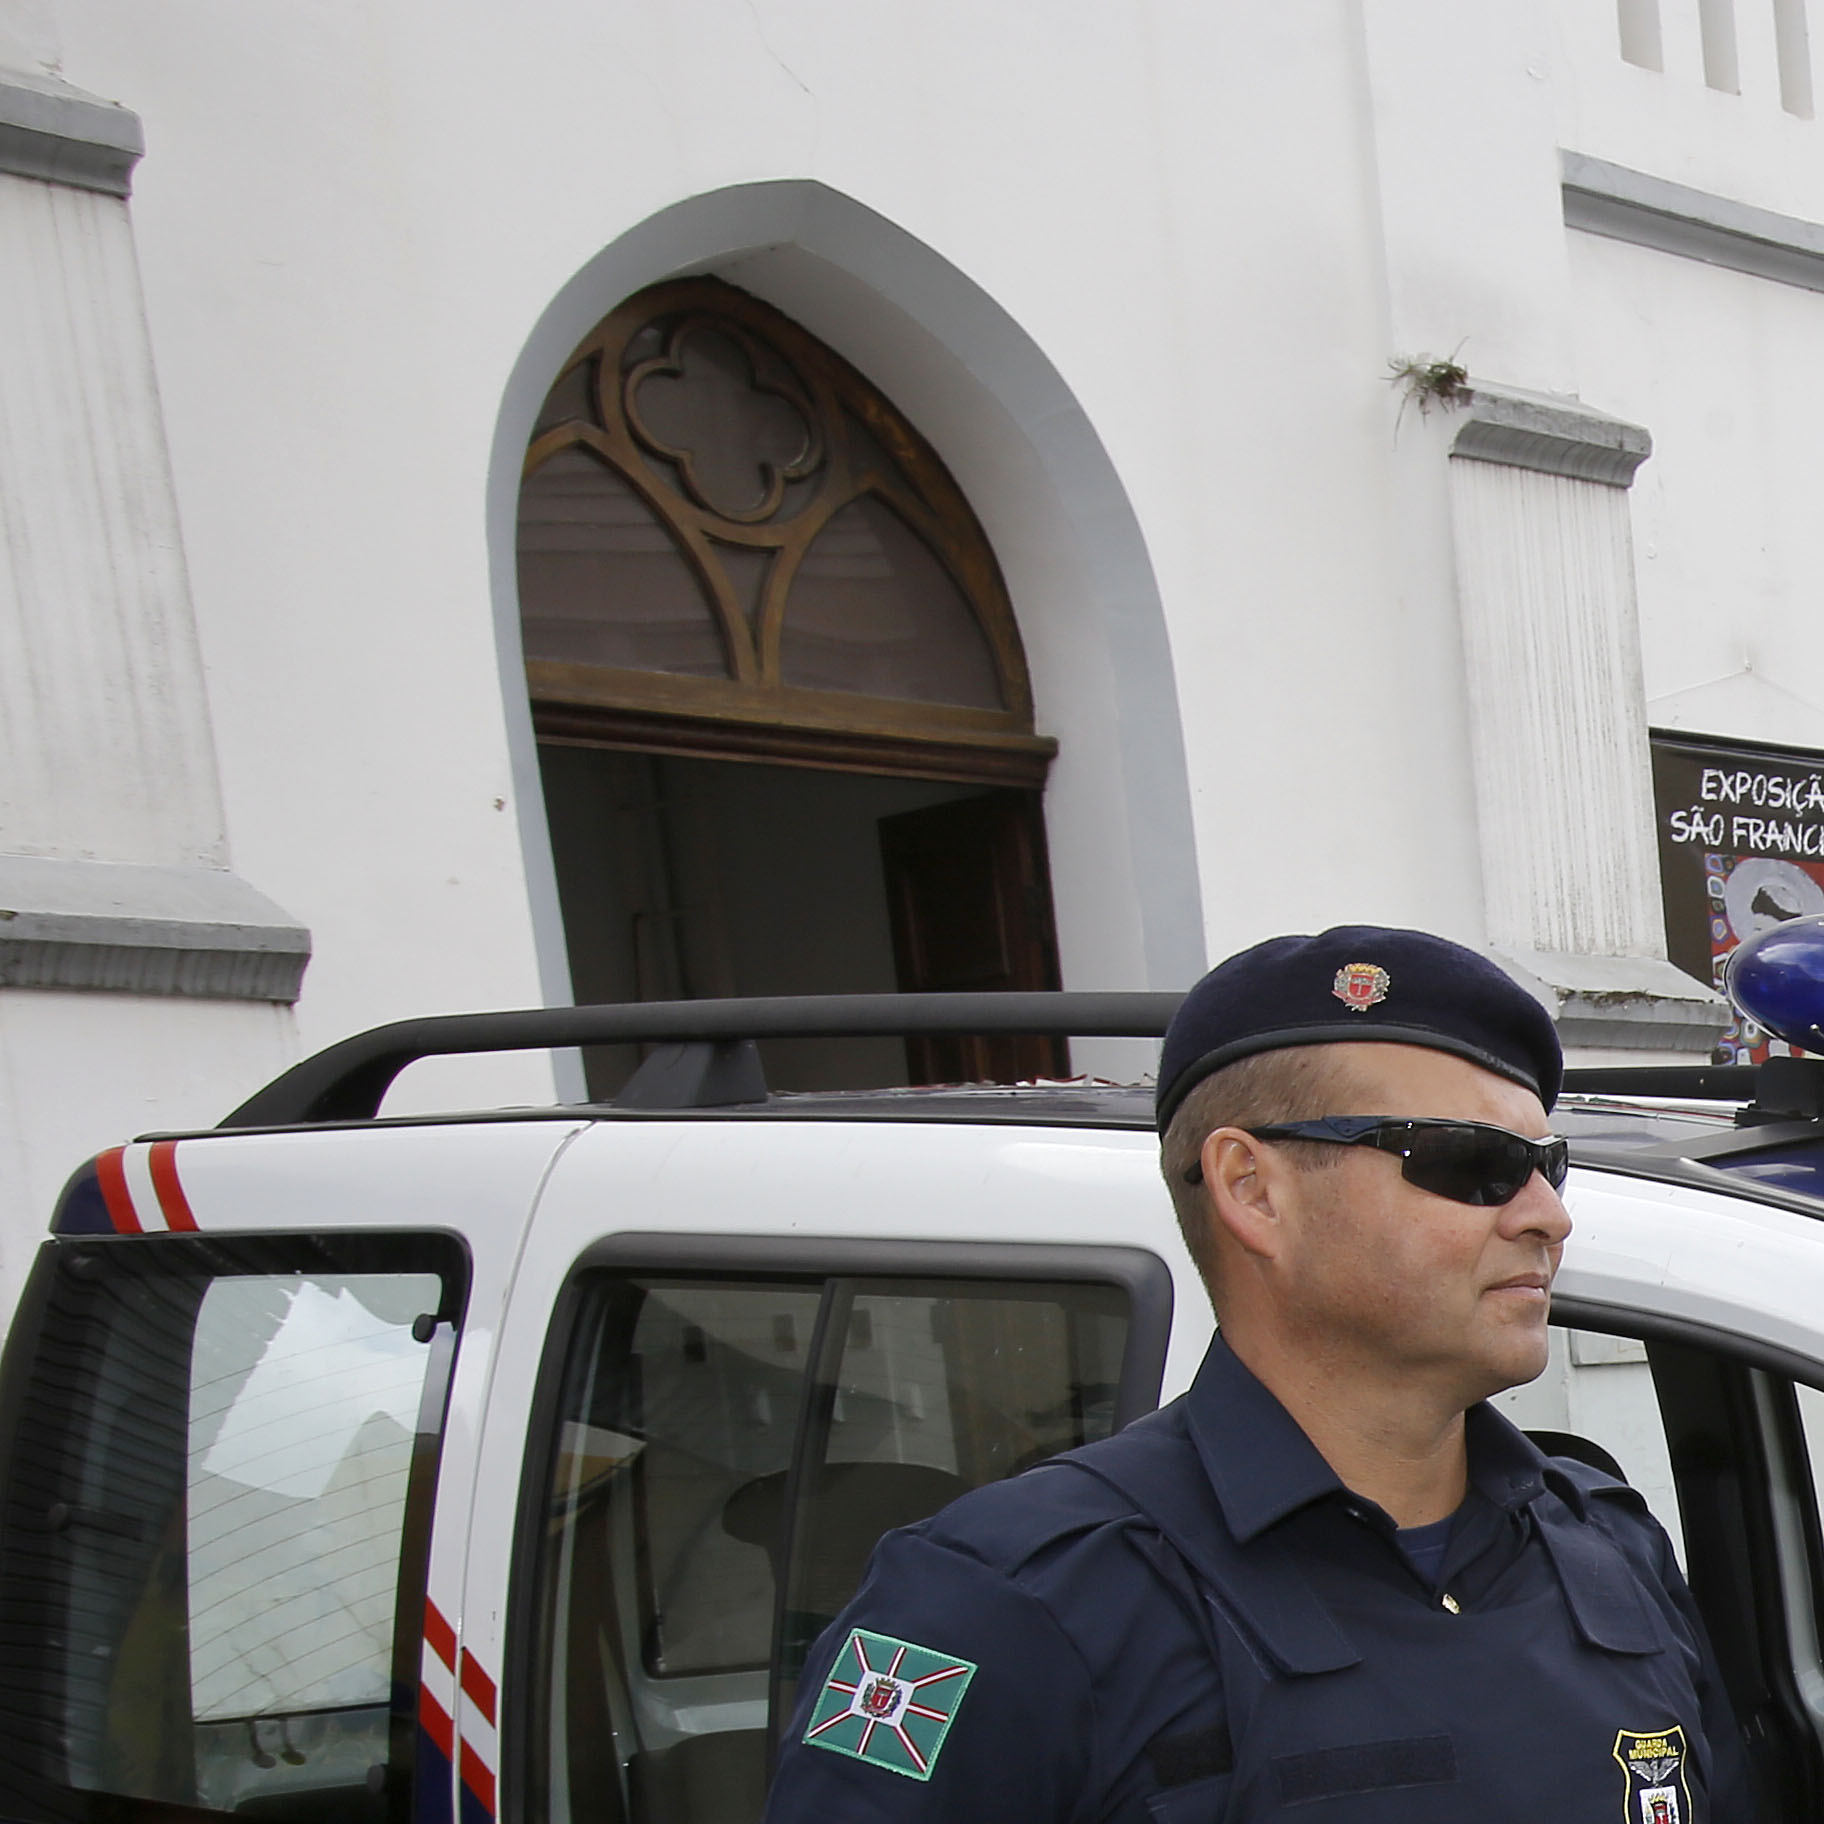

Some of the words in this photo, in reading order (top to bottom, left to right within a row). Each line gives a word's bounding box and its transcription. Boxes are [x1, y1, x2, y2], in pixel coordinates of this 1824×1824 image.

[1670, 805, 1725, 847] SÃO
[1635, 1738, 1668, 1749] GUARDA
[1628, 1746, 1679, 1760] MUNICIPAL
